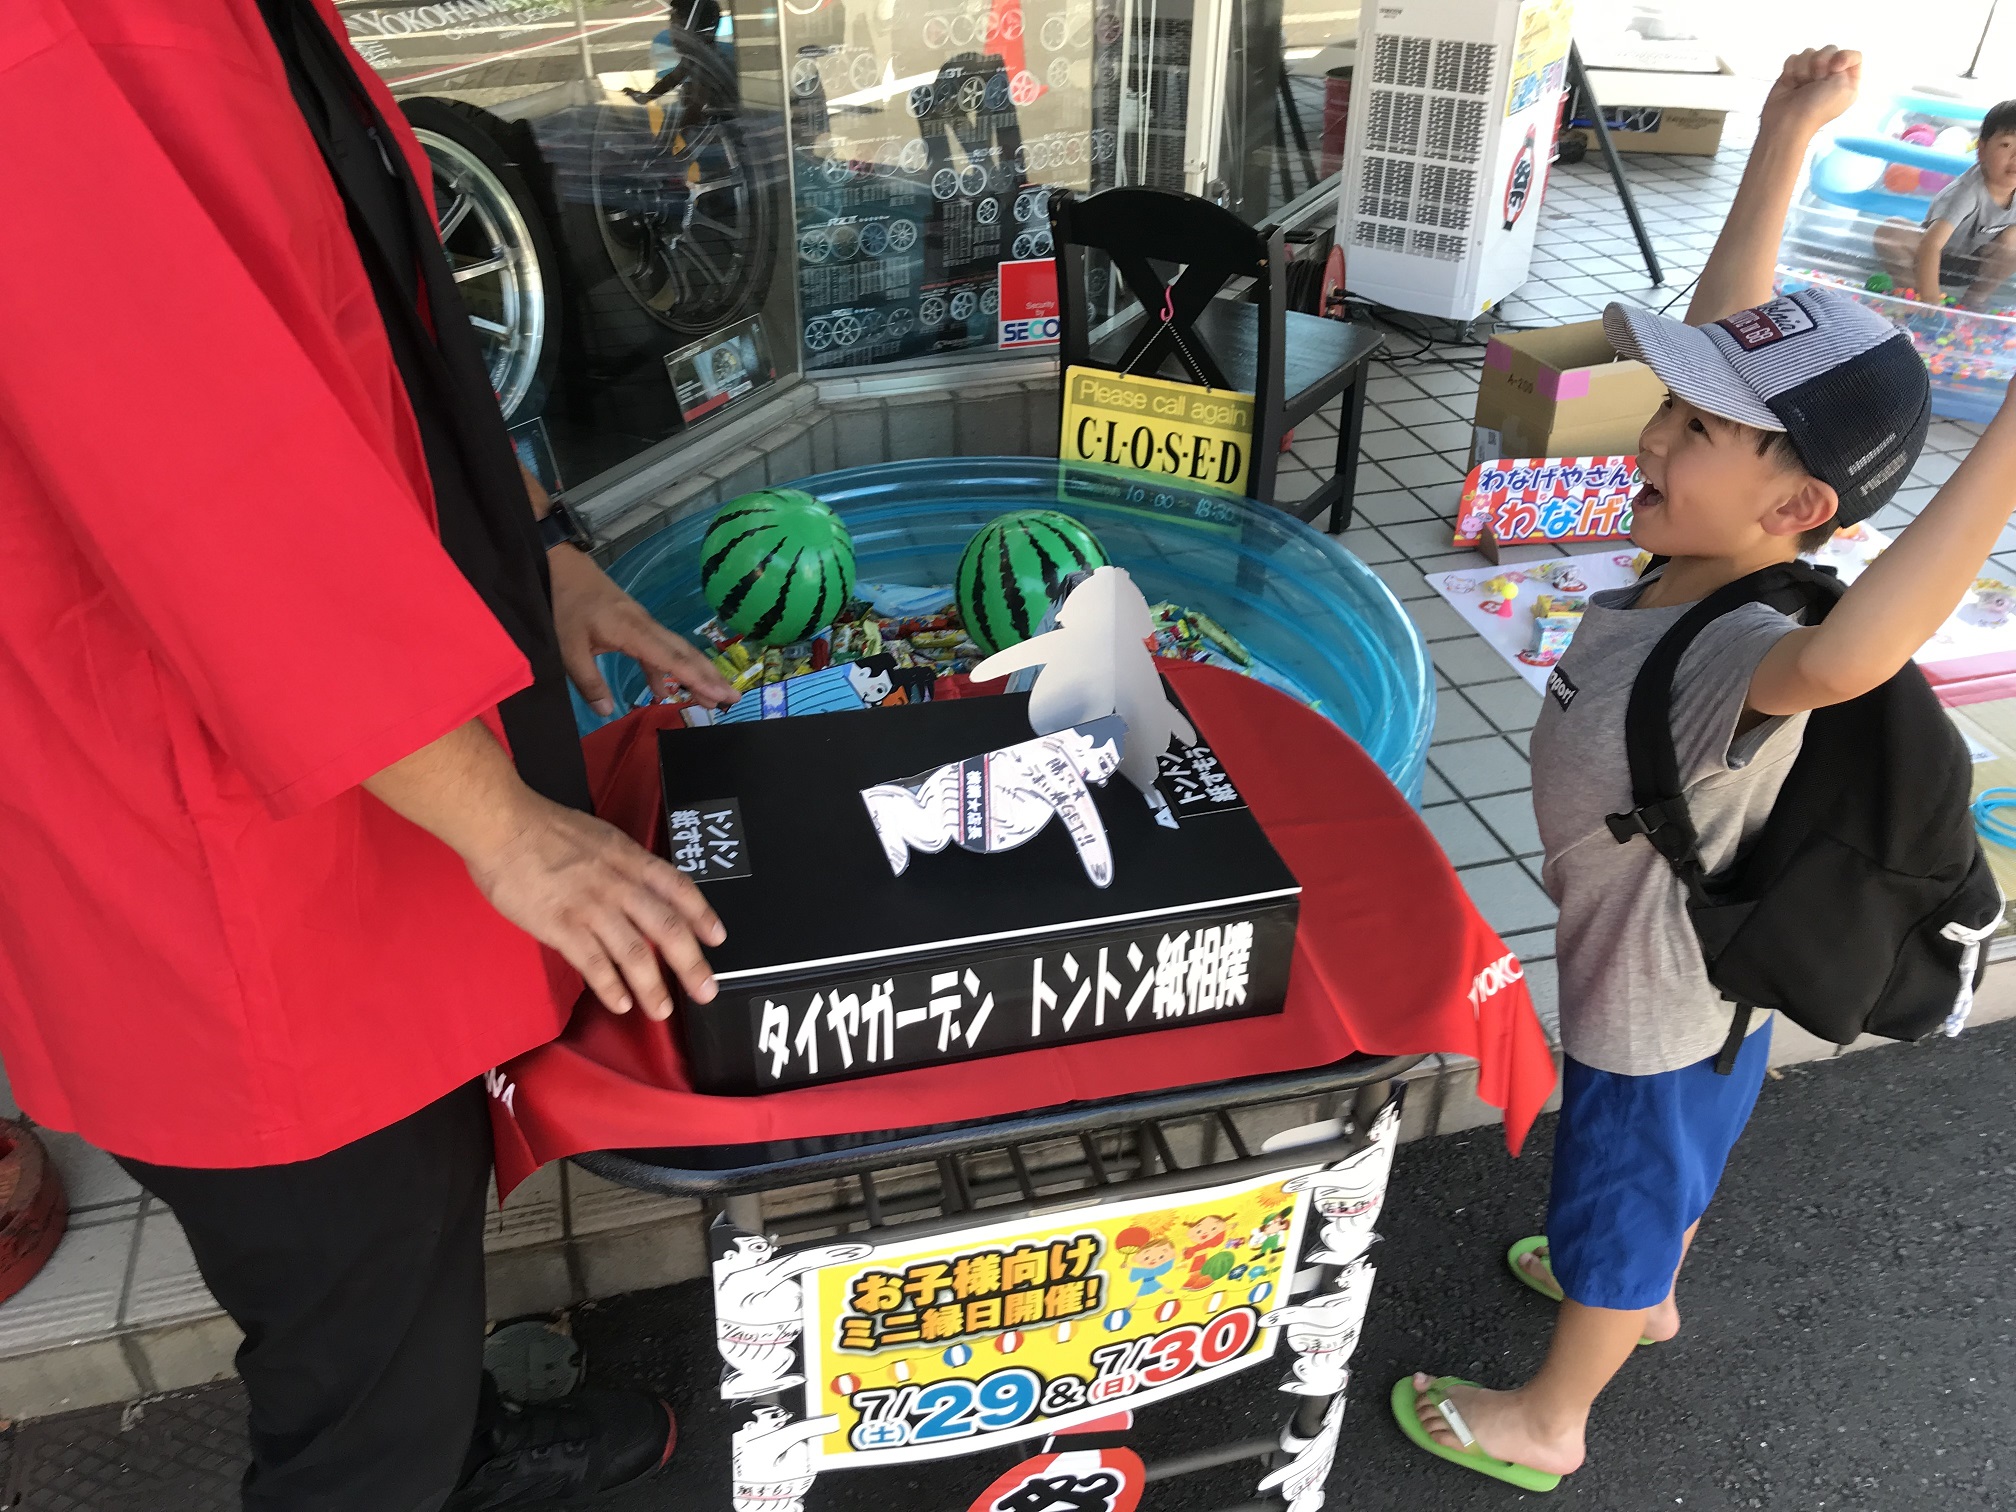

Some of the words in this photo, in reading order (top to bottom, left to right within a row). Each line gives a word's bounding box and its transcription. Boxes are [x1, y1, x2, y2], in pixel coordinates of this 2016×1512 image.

[1025, 301, 1055, 310] Security
[1035, 309, 1046, 317] by
[1080, 379, 1147, 410] Please
[1152, 394, 1187, 417] call
[1191, 401, 1247, 427] again
[703, 809, 740, 869] トントン
[757, 967, 995, 1080] タイヤガーデン
[1031, 920, 1255, 1037] トントン紙相撲
[852, 1238, 1098, 1314] お子様向け
[1044, 1376, 1086, 1413] &
